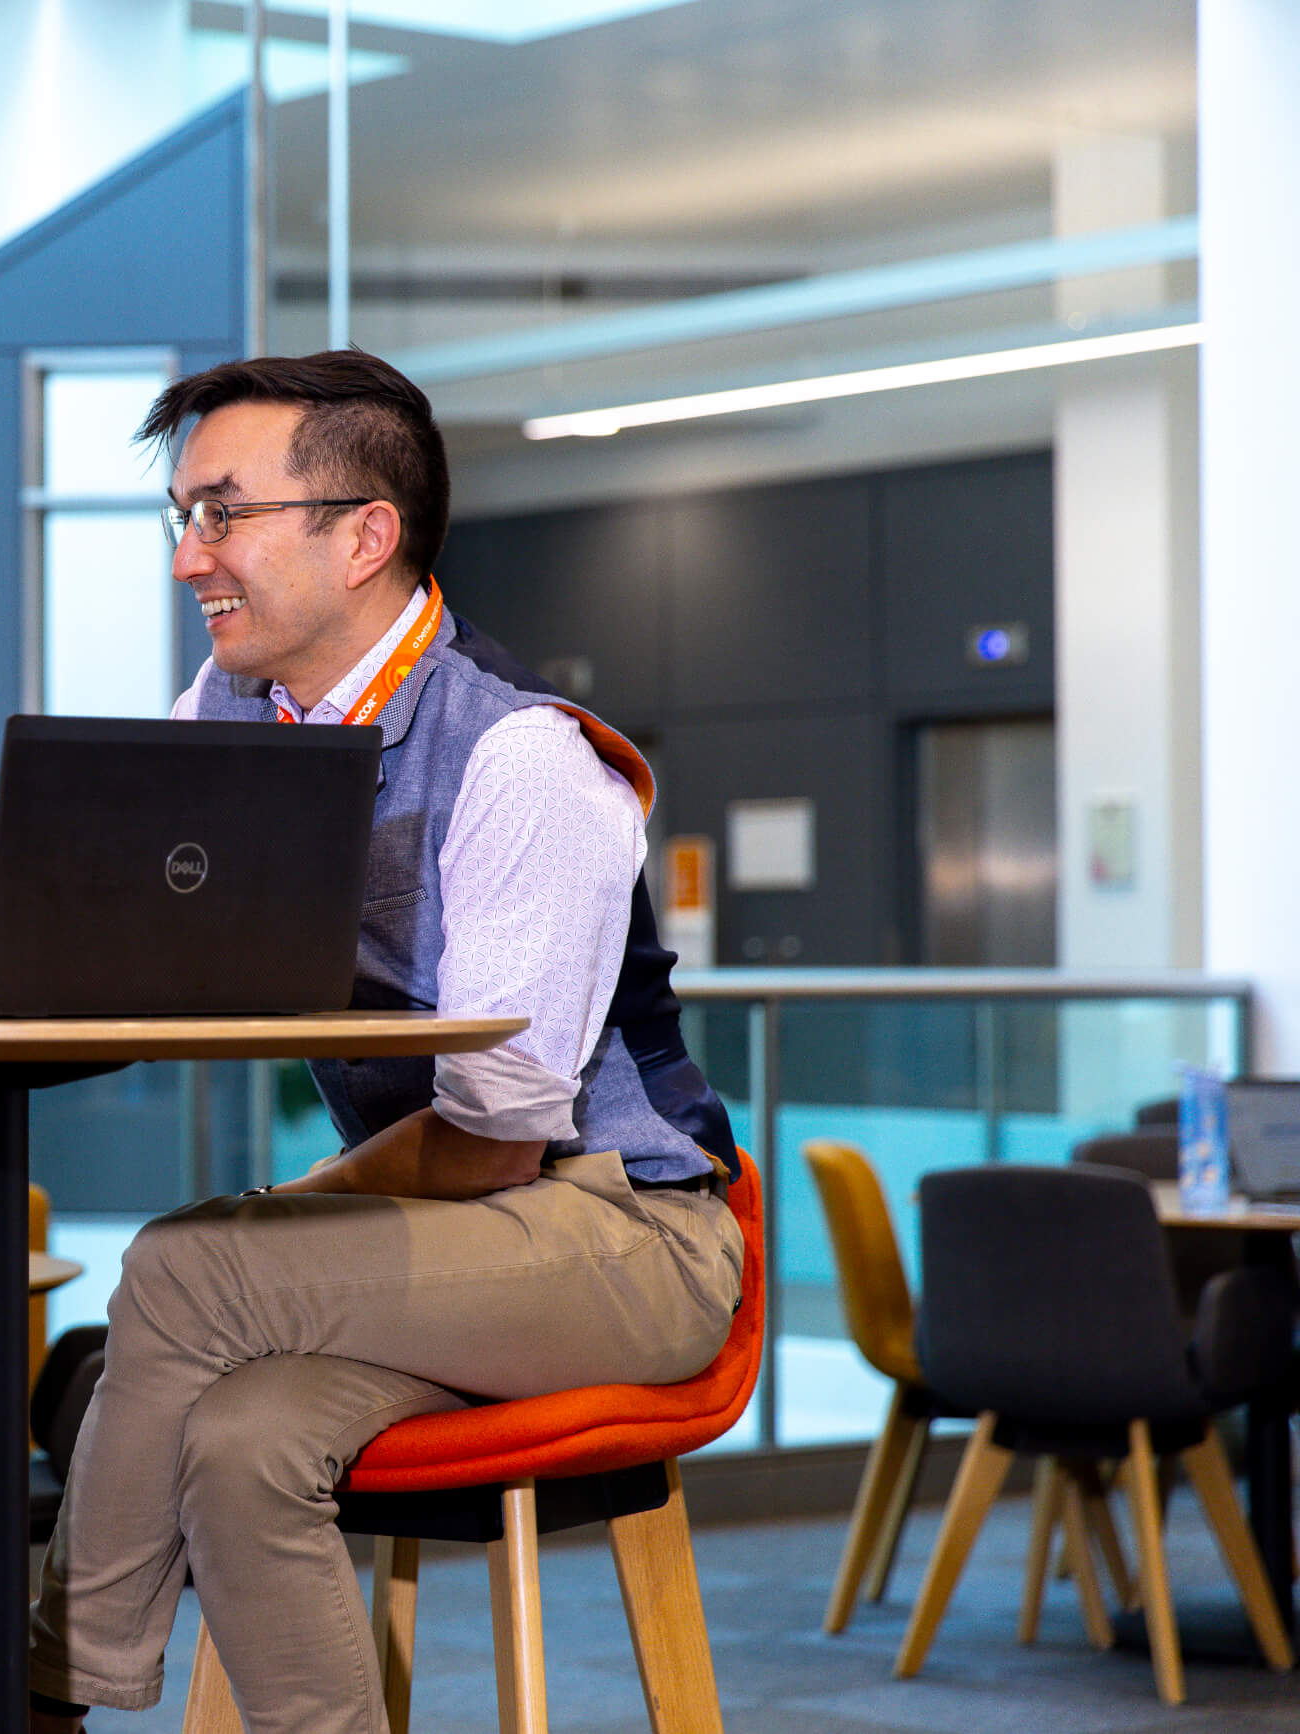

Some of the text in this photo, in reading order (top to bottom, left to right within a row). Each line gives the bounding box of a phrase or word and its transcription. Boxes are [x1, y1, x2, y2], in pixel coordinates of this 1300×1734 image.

[412, 641, 420, 649] a
[416, 621, 432, 642] better
[351, 698, 377, 725] MCOR
[172, 861, 202, 875] DELL
